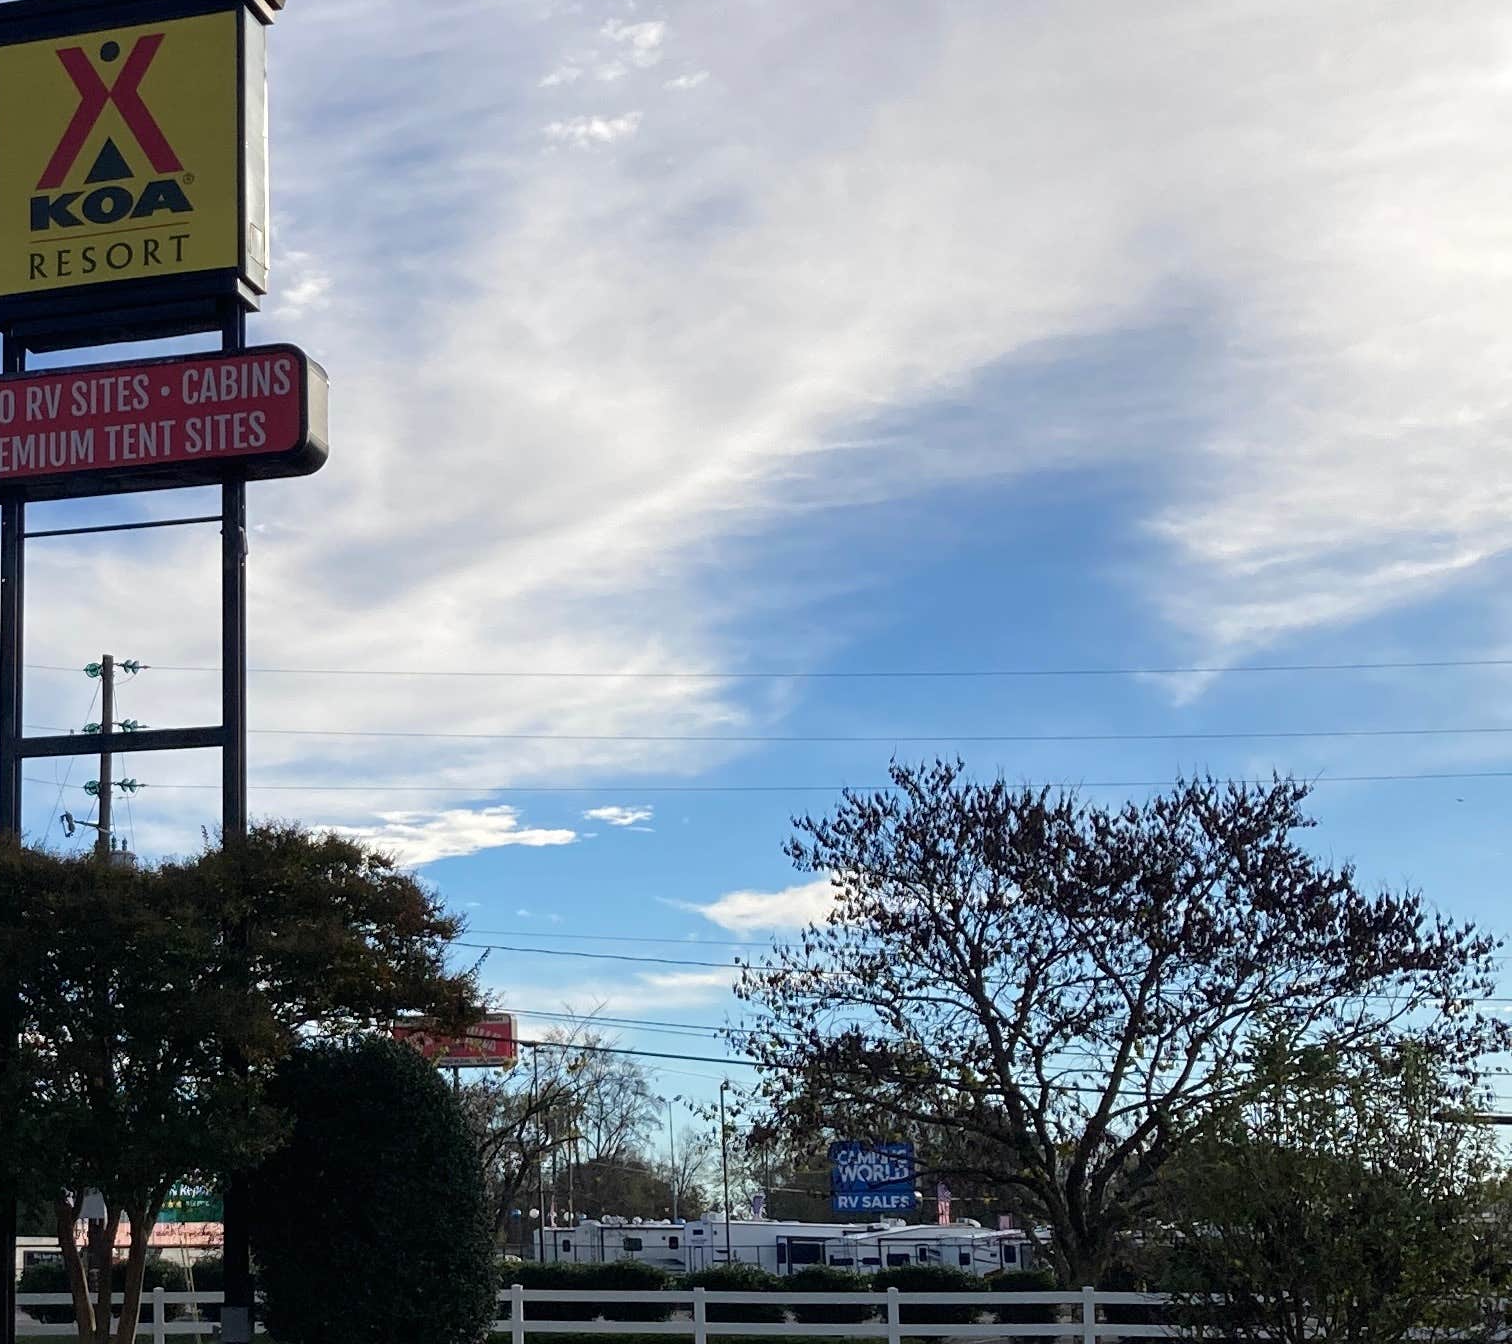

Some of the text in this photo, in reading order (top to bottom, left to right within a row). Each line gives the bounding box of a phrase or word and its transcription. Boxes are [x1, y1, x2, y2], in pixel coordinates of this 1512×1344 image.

[30, 179, 194, 232] KOA
[29, 234, 191, 280] RESORT
[26, 384, 62, 422] RV
[71, 373, 149, 417] SITES
[182, 358, 292, 405] CABINS
[104, 420, 176, 462] TENT
[185, 410, 266, 453] SITES
[838, 1164, 909, 1183] WORLD
[838, 1196, 910, 1208] RV SALES
